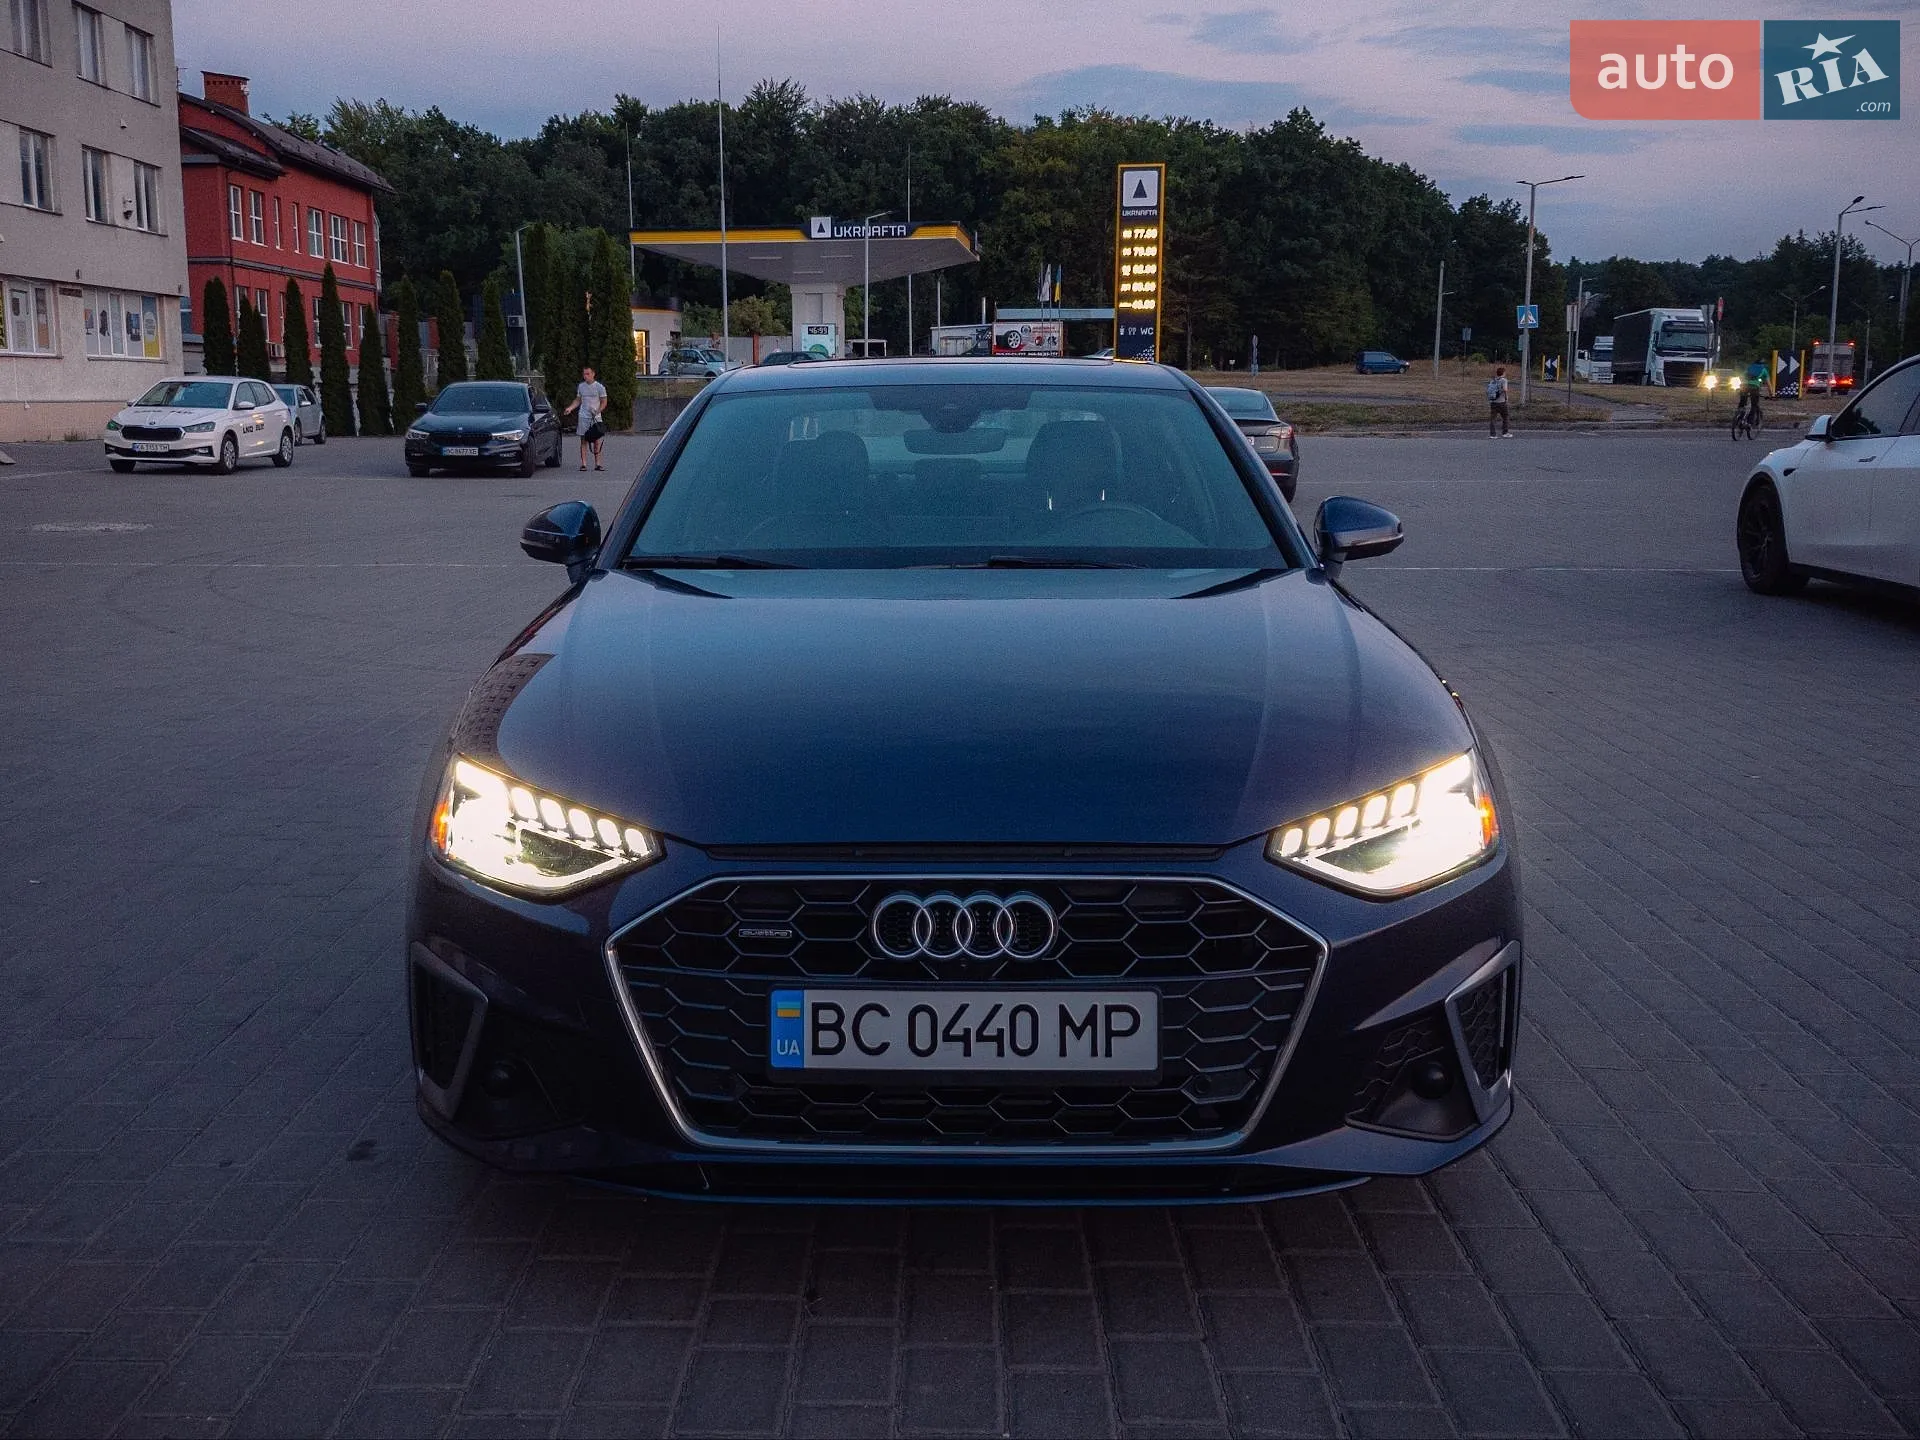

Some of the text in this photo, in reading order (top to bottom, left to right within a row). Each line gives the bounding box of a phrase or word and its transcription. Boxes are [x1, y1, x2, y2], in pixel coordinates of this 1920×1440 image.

[1122, 209, 1157, 217] UKRNAFTA
[833, 225, 907, 238] UKRNAFTA
[1140, 326, 1154, 335] WC
[811, 1002, 1142, 1059] BC 0440 MP
[776, 1039, 801, 1056] UA
